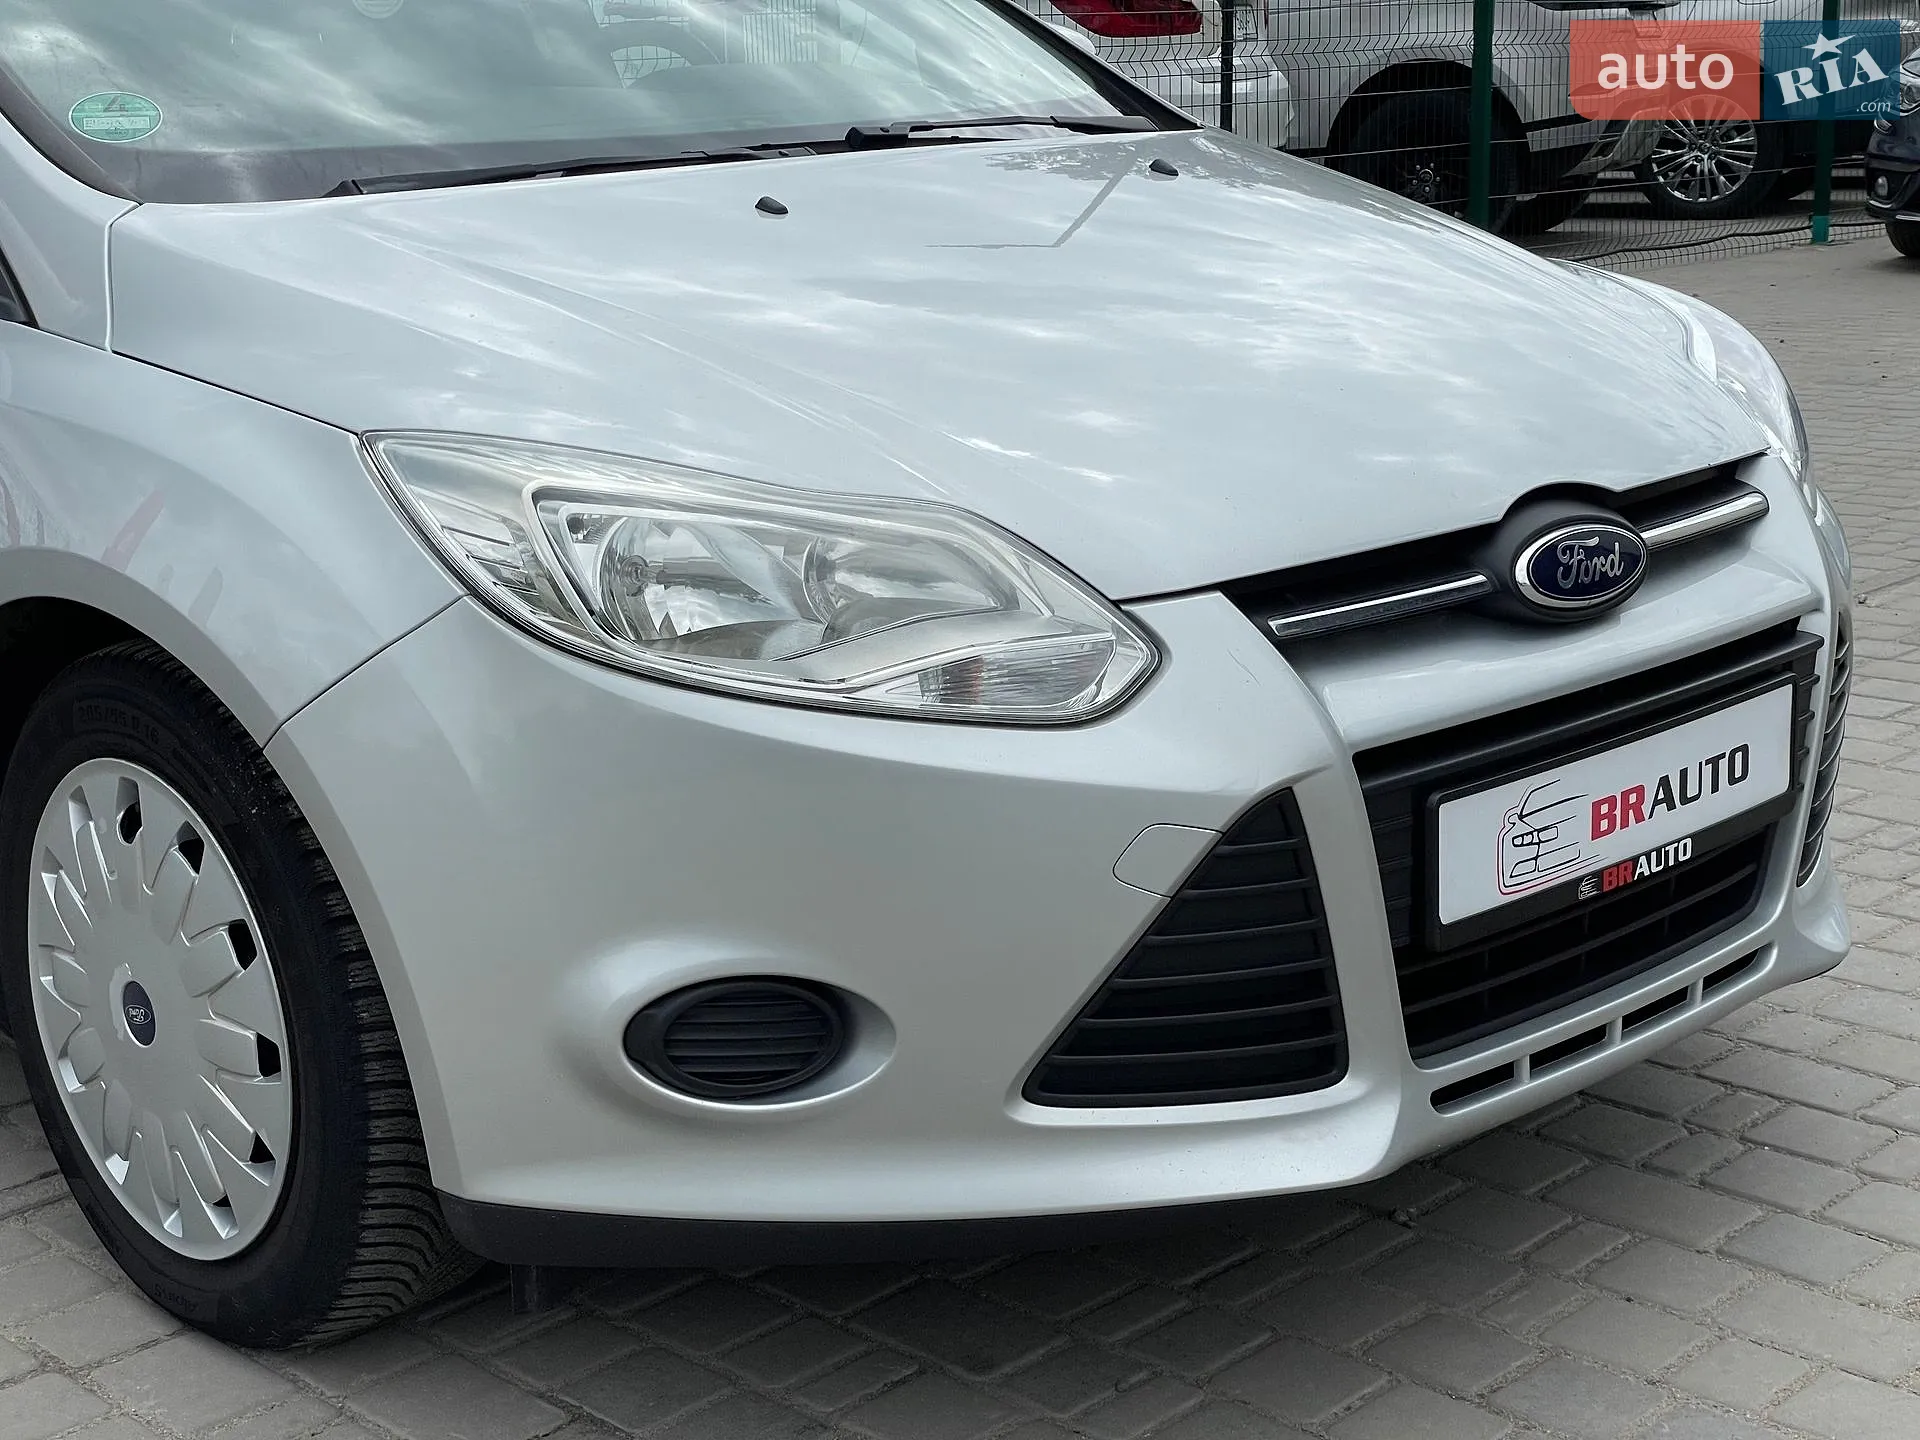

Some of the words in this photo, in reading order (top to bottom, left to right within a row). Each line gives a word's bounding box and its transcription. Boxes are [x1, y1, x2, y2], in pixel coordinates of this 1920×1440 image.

[1556, 536, 1624, 589] Ford
[1591, 743, 1749, 841] BRAUTO
[1602, 837, 1692, 893] BRAUTO
